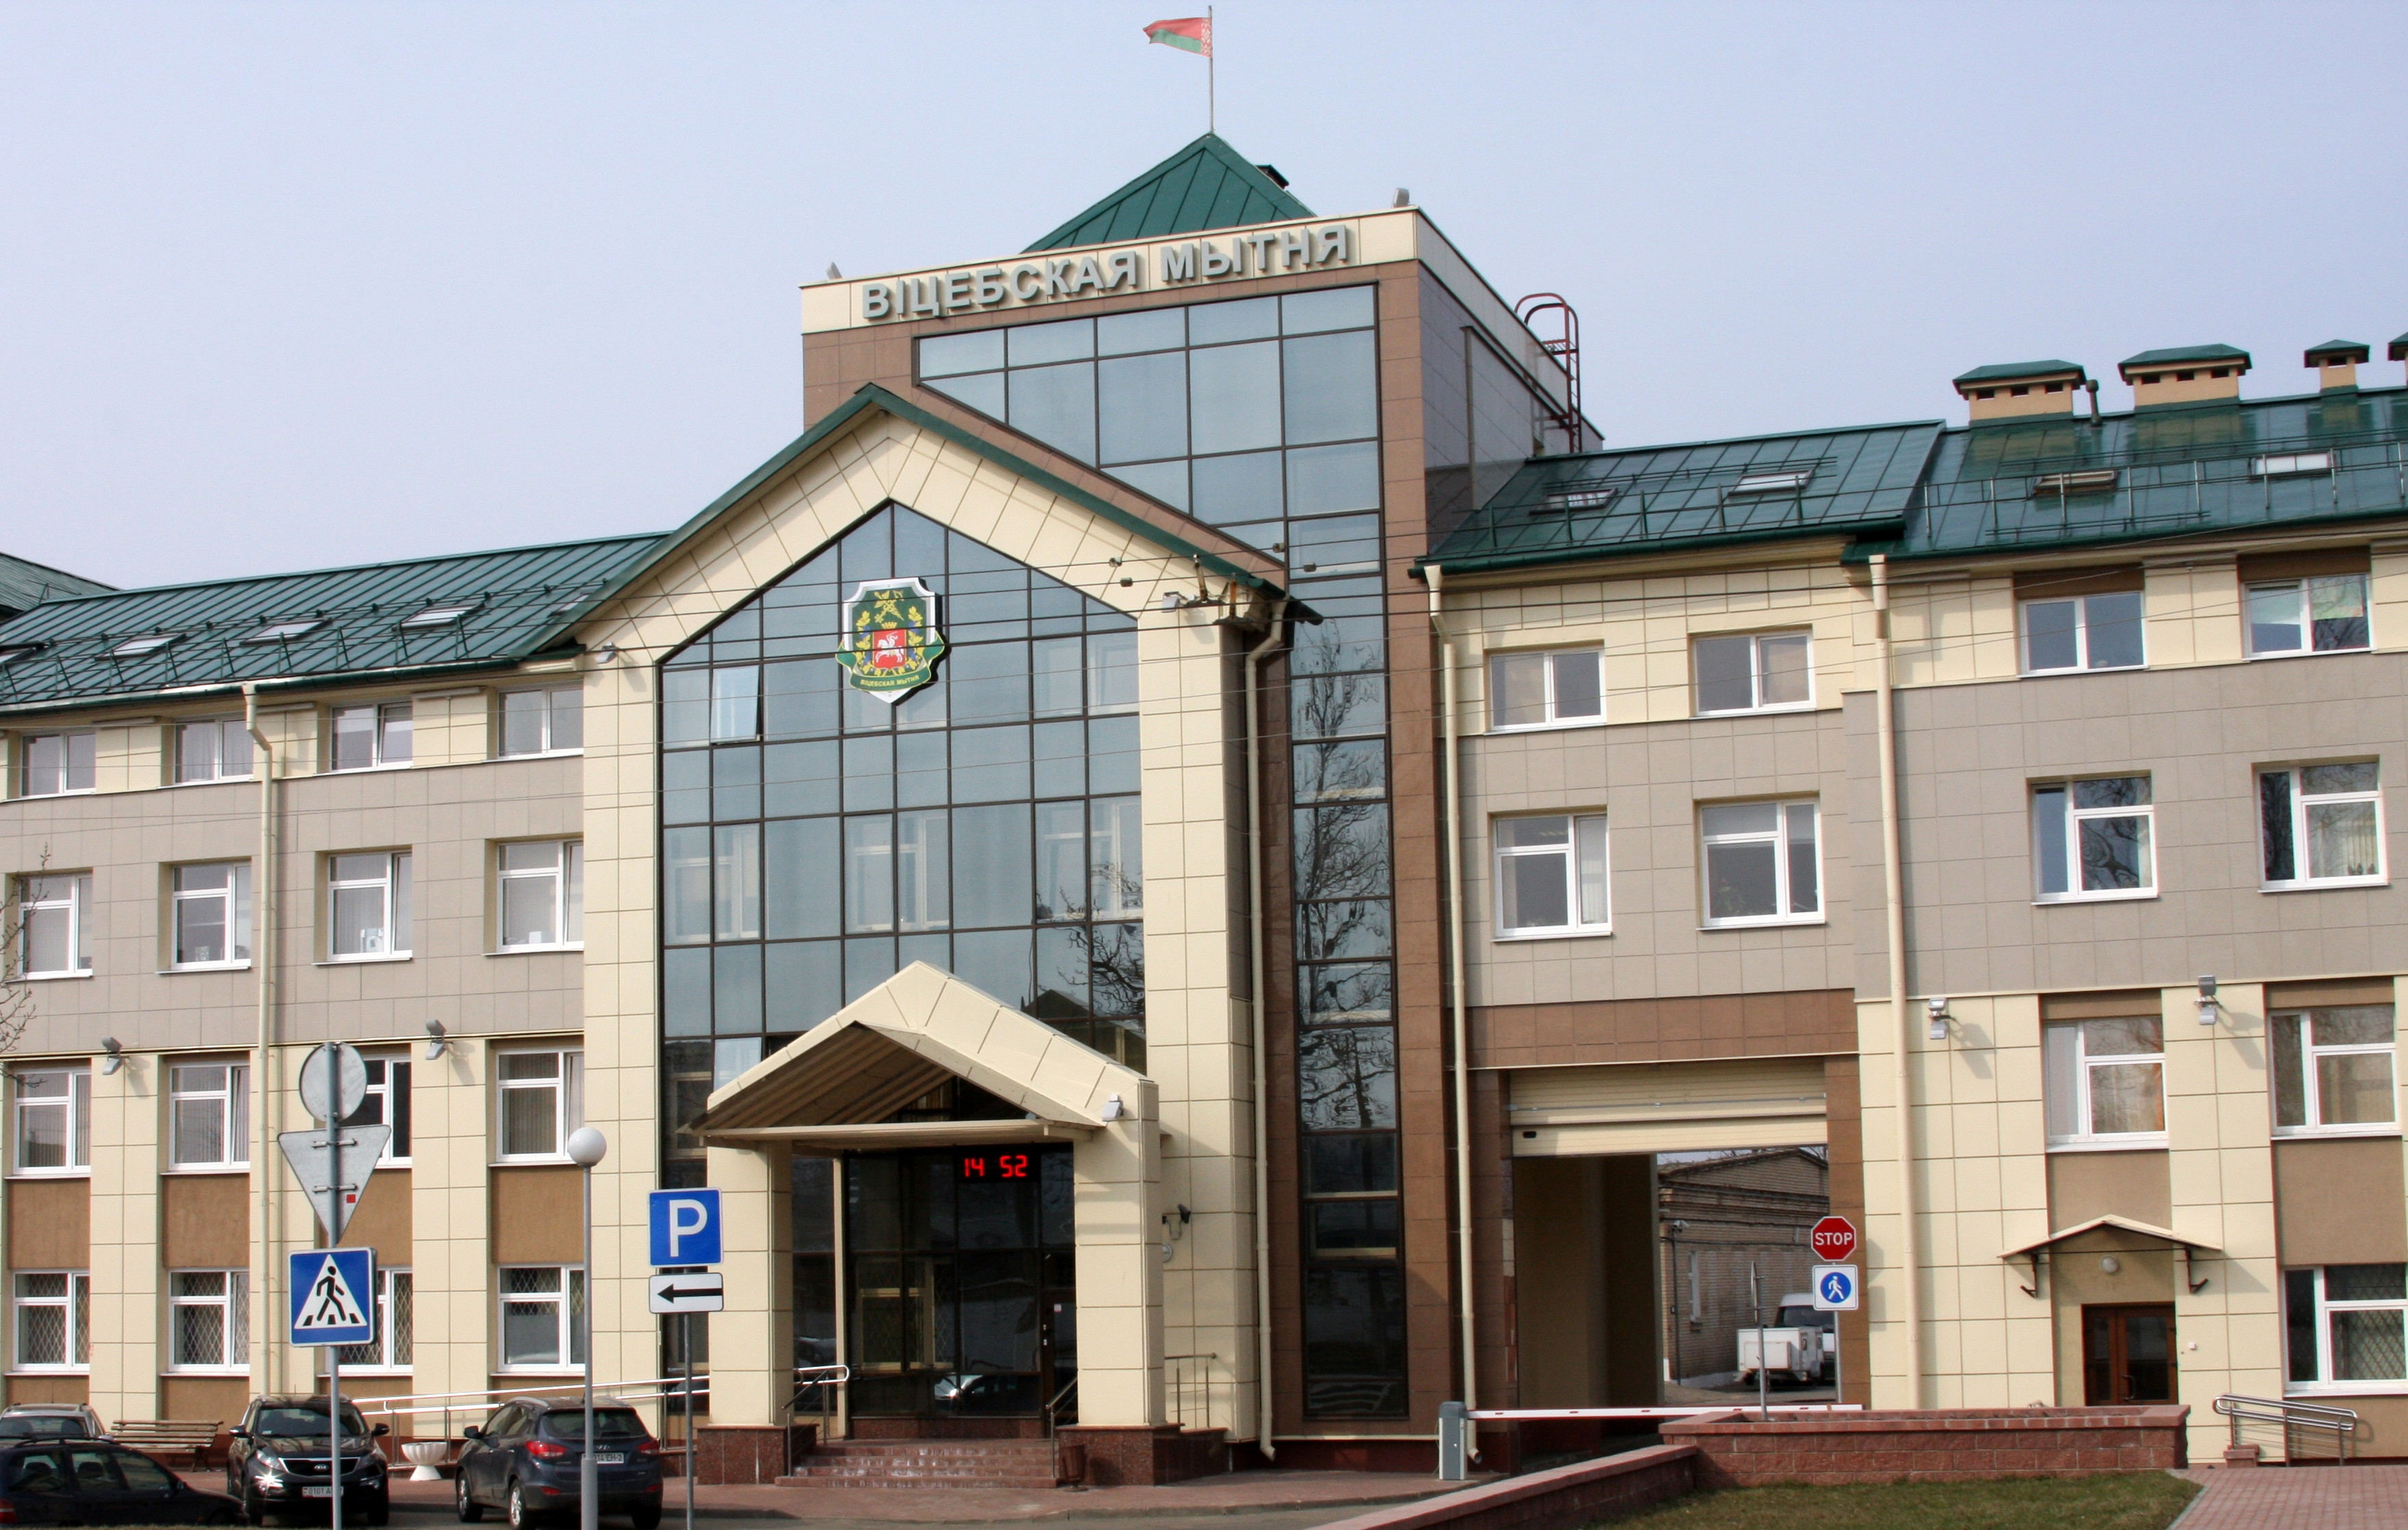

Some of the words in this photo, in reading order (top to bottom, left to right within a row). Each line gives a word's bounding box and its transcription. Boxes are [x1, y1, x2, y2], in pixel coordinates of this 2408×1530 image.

[862, 251, 1137, 319] ВІЦЕБСКАЯ
[1161, 225, 1346, 282] МЫТНЯ
[964, 1157, 985, 1177] 14
[1000, 1155, 1027, 1178] 52
[669, 1199, 707, 1257] P
[1815, 1232, 1853, 1245] STOP
